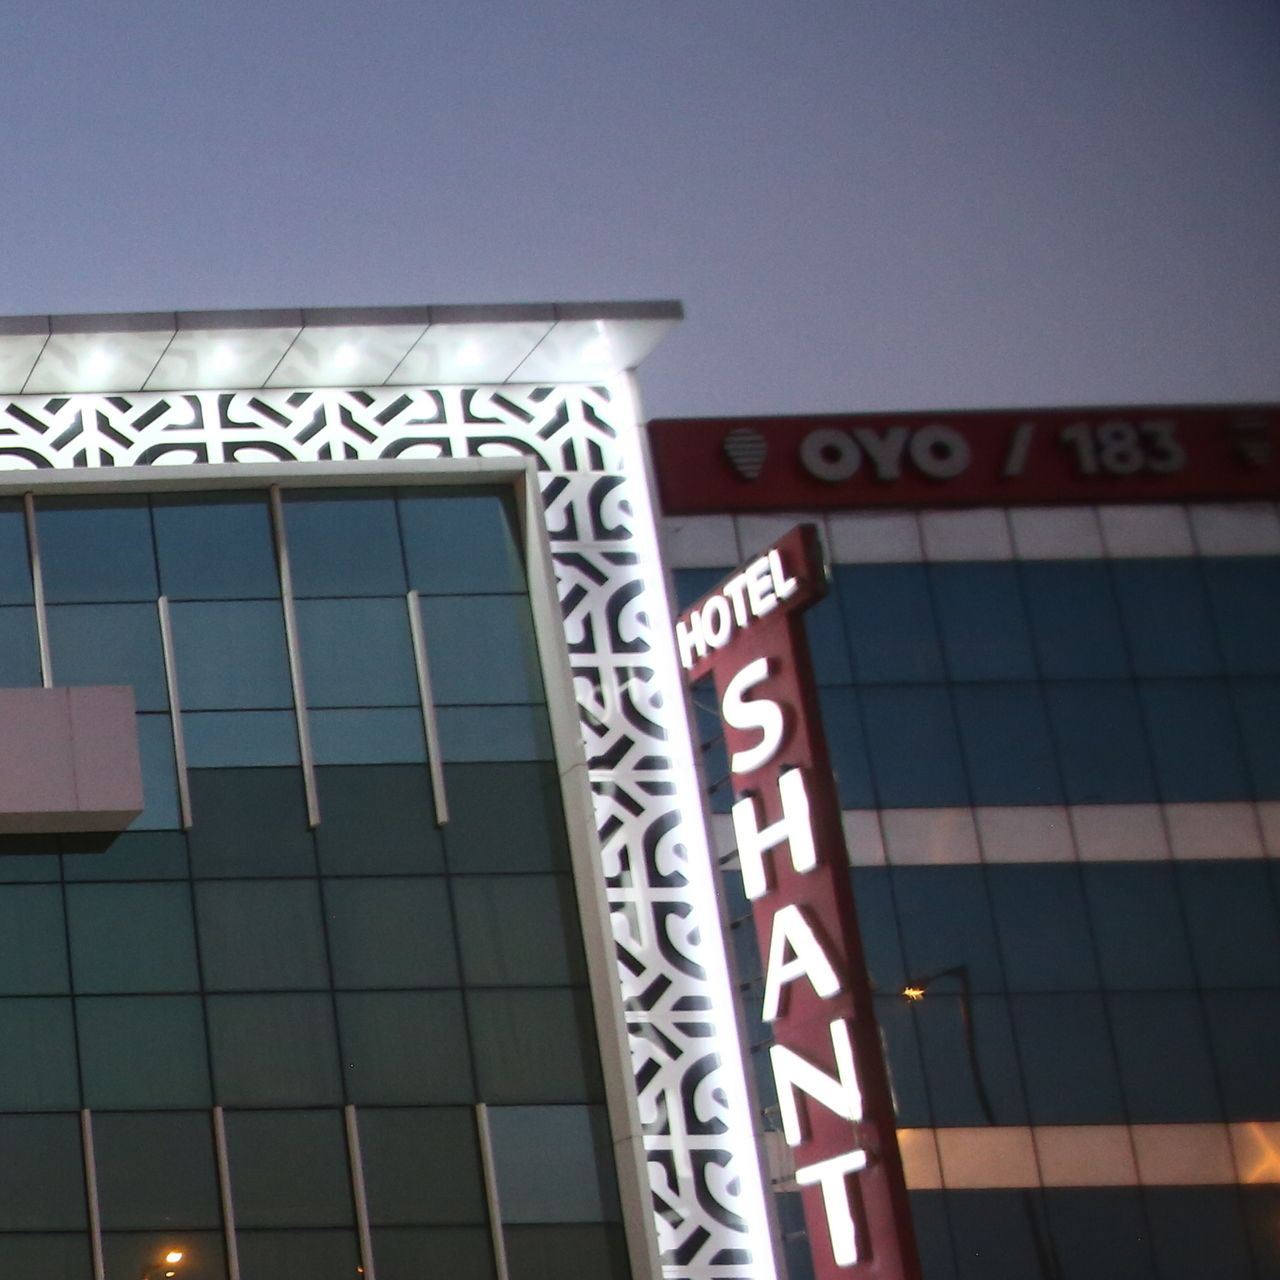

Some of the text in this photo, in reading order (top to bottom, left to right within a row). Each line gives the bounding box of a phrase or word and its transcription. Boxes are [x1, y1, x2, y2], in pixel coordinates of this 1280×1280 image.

[800, 425, 971, 482] OYO
[1060, 420, 1186, 476] 183
[676, 548, 797, 668] HOTEL
